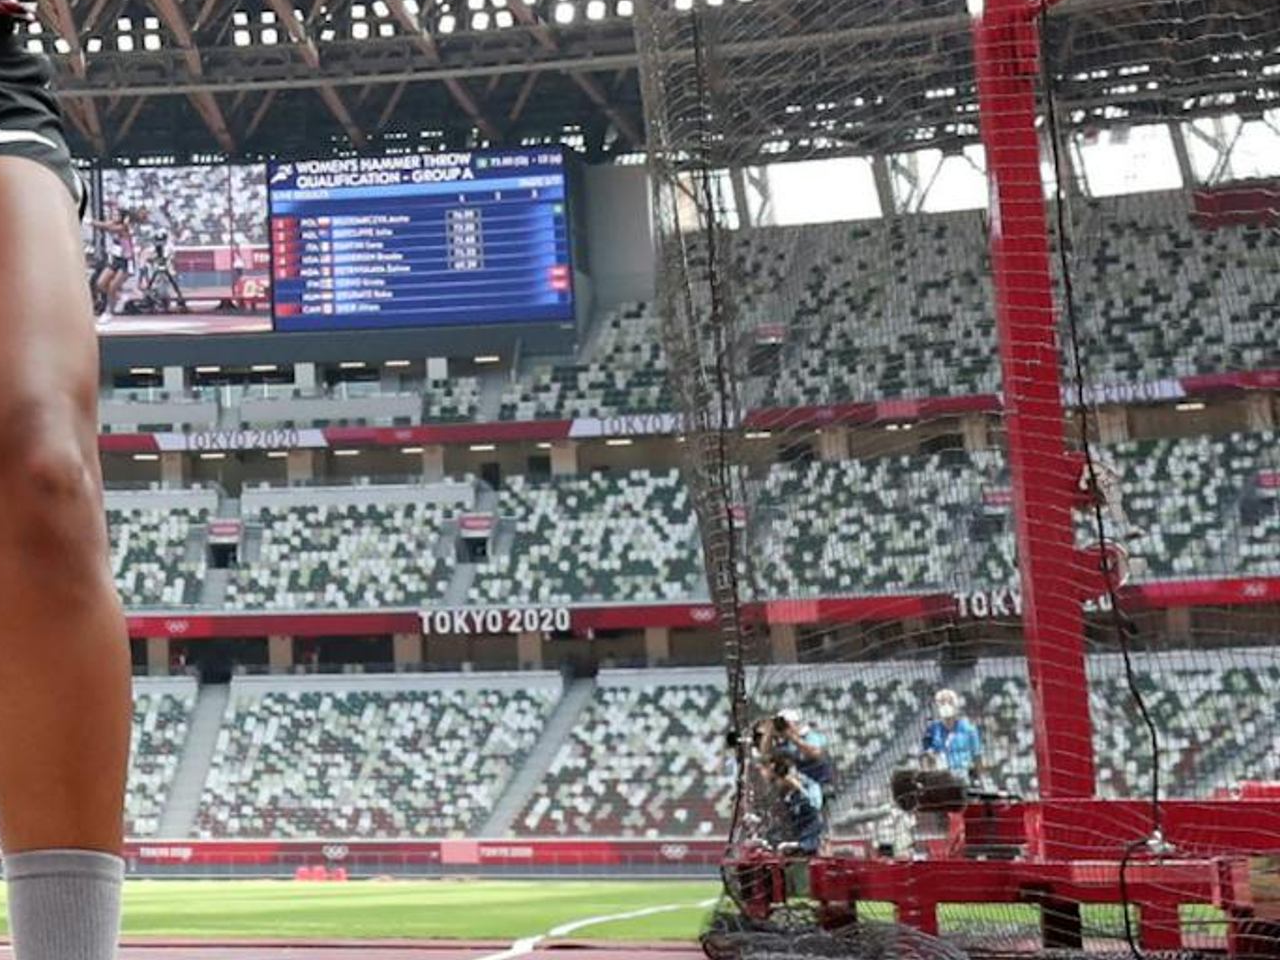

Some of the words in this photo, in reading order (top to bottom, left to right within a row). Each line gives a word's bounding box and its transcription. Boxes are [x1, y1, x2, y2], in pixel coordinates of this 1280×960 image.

[295, 159, 358, 174] WOMEN'S
[361, 156, 421, 172] HAMMER
[423, 152, 472, 168] THROW
[296, 171, 401, 189] QUALIFICATION
[411, 168, 461, 183] GROUP
[462, 167, 474, 180] A
[596, 414, 663, 436] TOKYO
[182, 430, 246, 451] TOKYO
[252, 428, 299, 449] 2020
[418, 608, 503, 635] TOKYO
[507, 606, 571, 633] 2020
